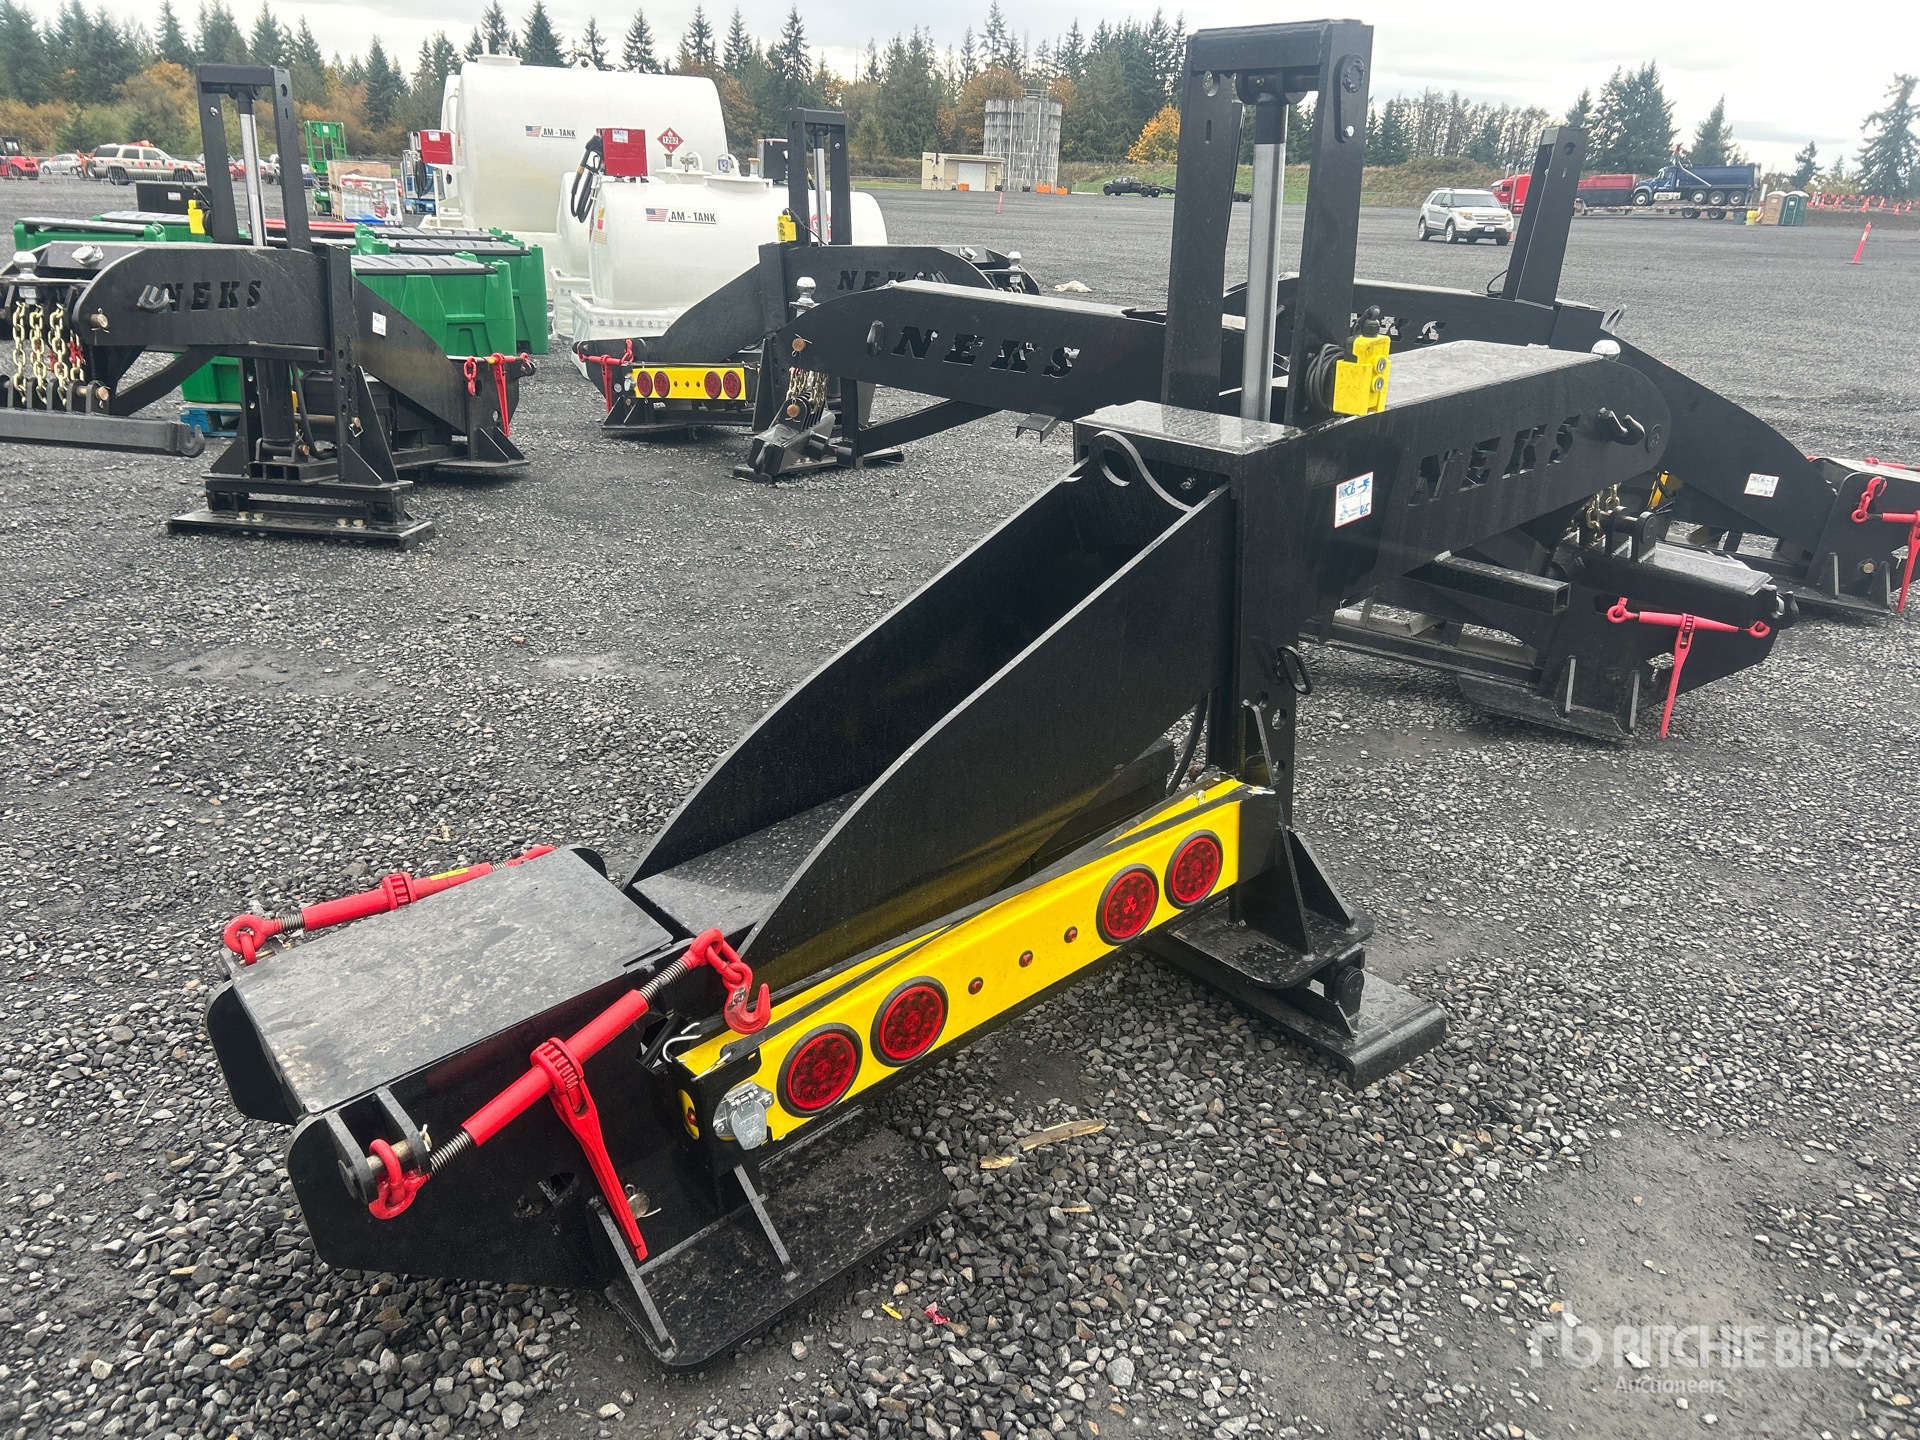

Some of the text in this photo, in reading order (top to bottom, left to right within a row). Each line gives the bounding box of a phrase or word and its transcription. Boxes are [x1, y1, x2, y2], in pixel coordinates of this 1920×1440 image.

[543, 127, 554, 136] AM
[559, 128, 576, 138] TANK
[671, 211, 685, 221] AM
[693, 212, 716, 222] TANK
[158, 280, 262, 313] NEKS
[891, 325, 1081, 379] NEKS
[1407, 414, 1581, 507] NEKS
